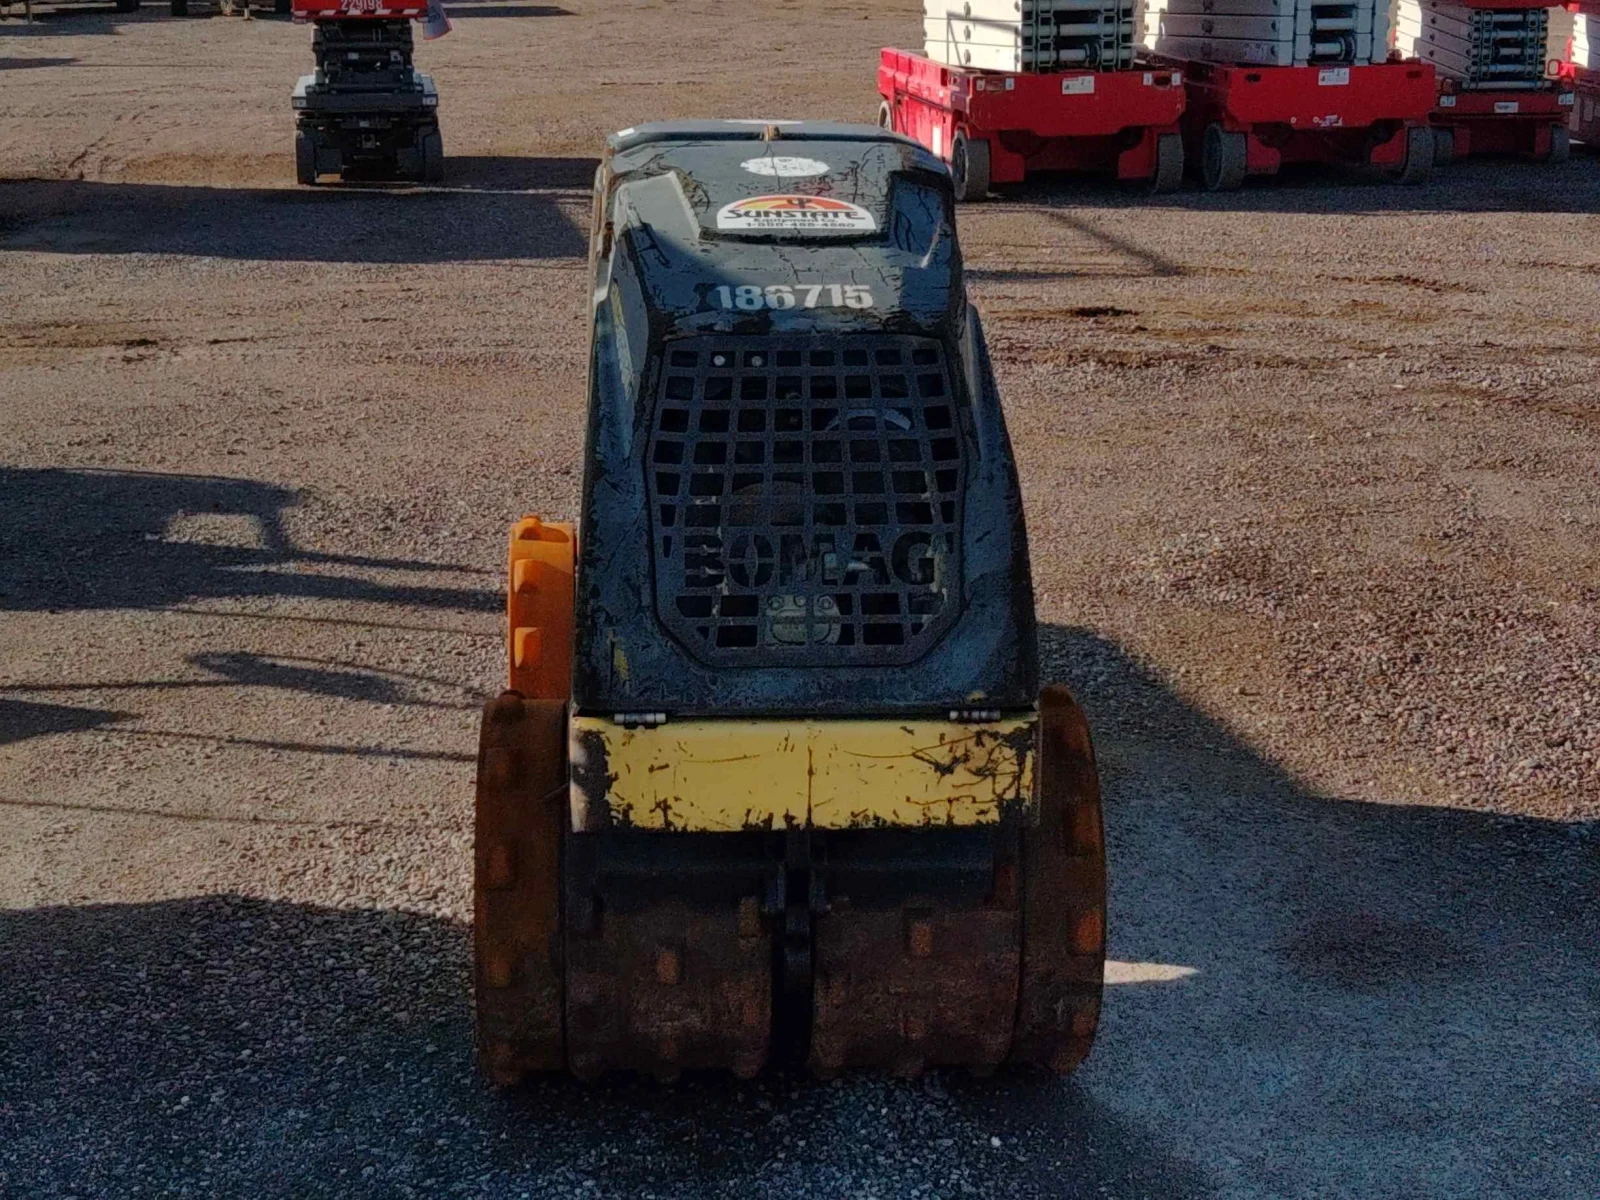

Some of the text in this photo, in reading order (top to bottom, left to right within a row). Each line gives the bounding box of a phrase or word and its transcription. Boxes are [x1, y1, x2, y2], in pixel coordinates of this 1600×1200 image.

[724, 209, 865, 220] SUNSTATE
[715, 284, 874, 310] 186715
[683, 531, 937, 588] BOMAG
